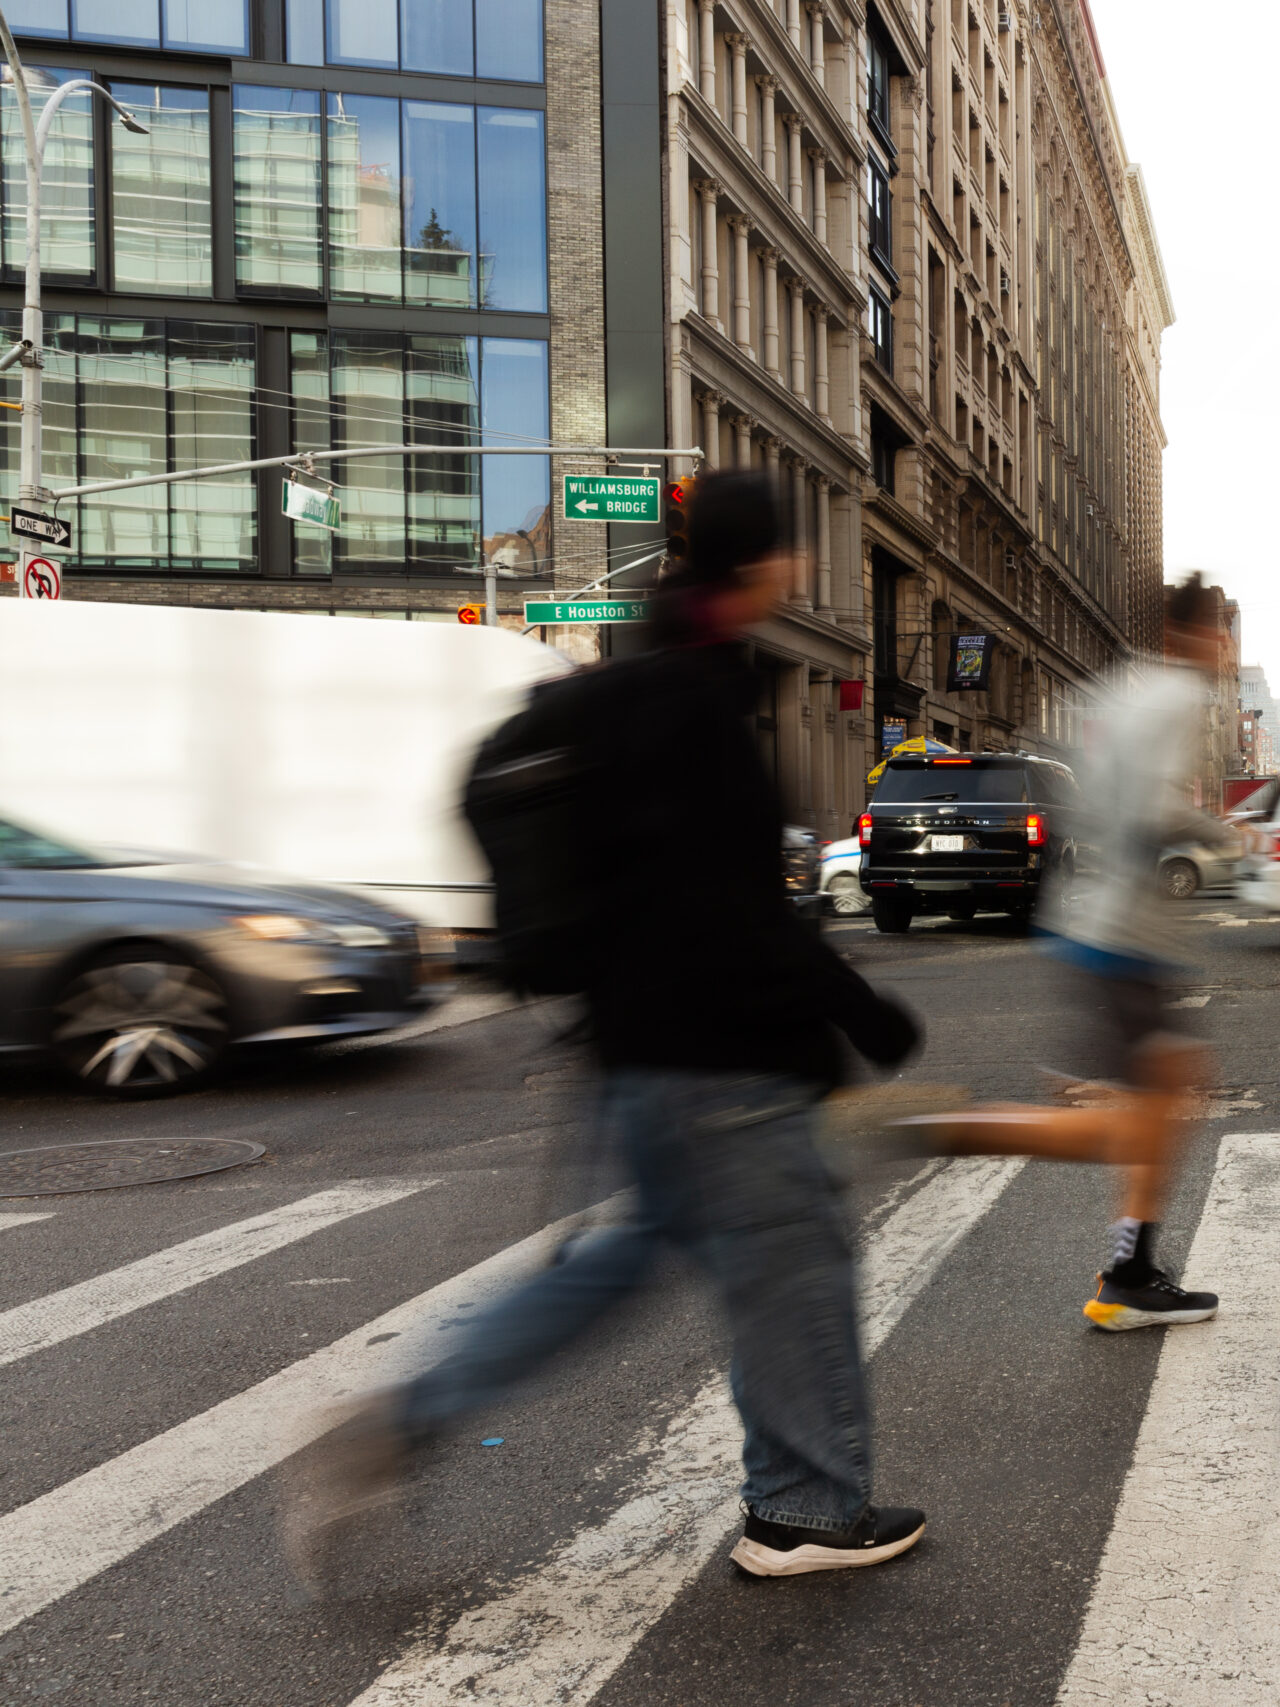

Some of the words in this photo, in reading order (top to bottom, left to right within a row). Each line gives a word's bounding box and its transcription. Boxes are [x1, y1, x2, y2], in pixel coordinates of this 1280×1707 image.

[569, 482, 655, 496] WILLIAMSBURG
[606, 501, 648, 514] BRIDGE
[20, 517, 38, 532] ONE
[45, 524, 63, 538] WAY
[555, 606, 563, 619] E
[568, 605, 626, 619] Houston
[631, 604, 644, 617] St
